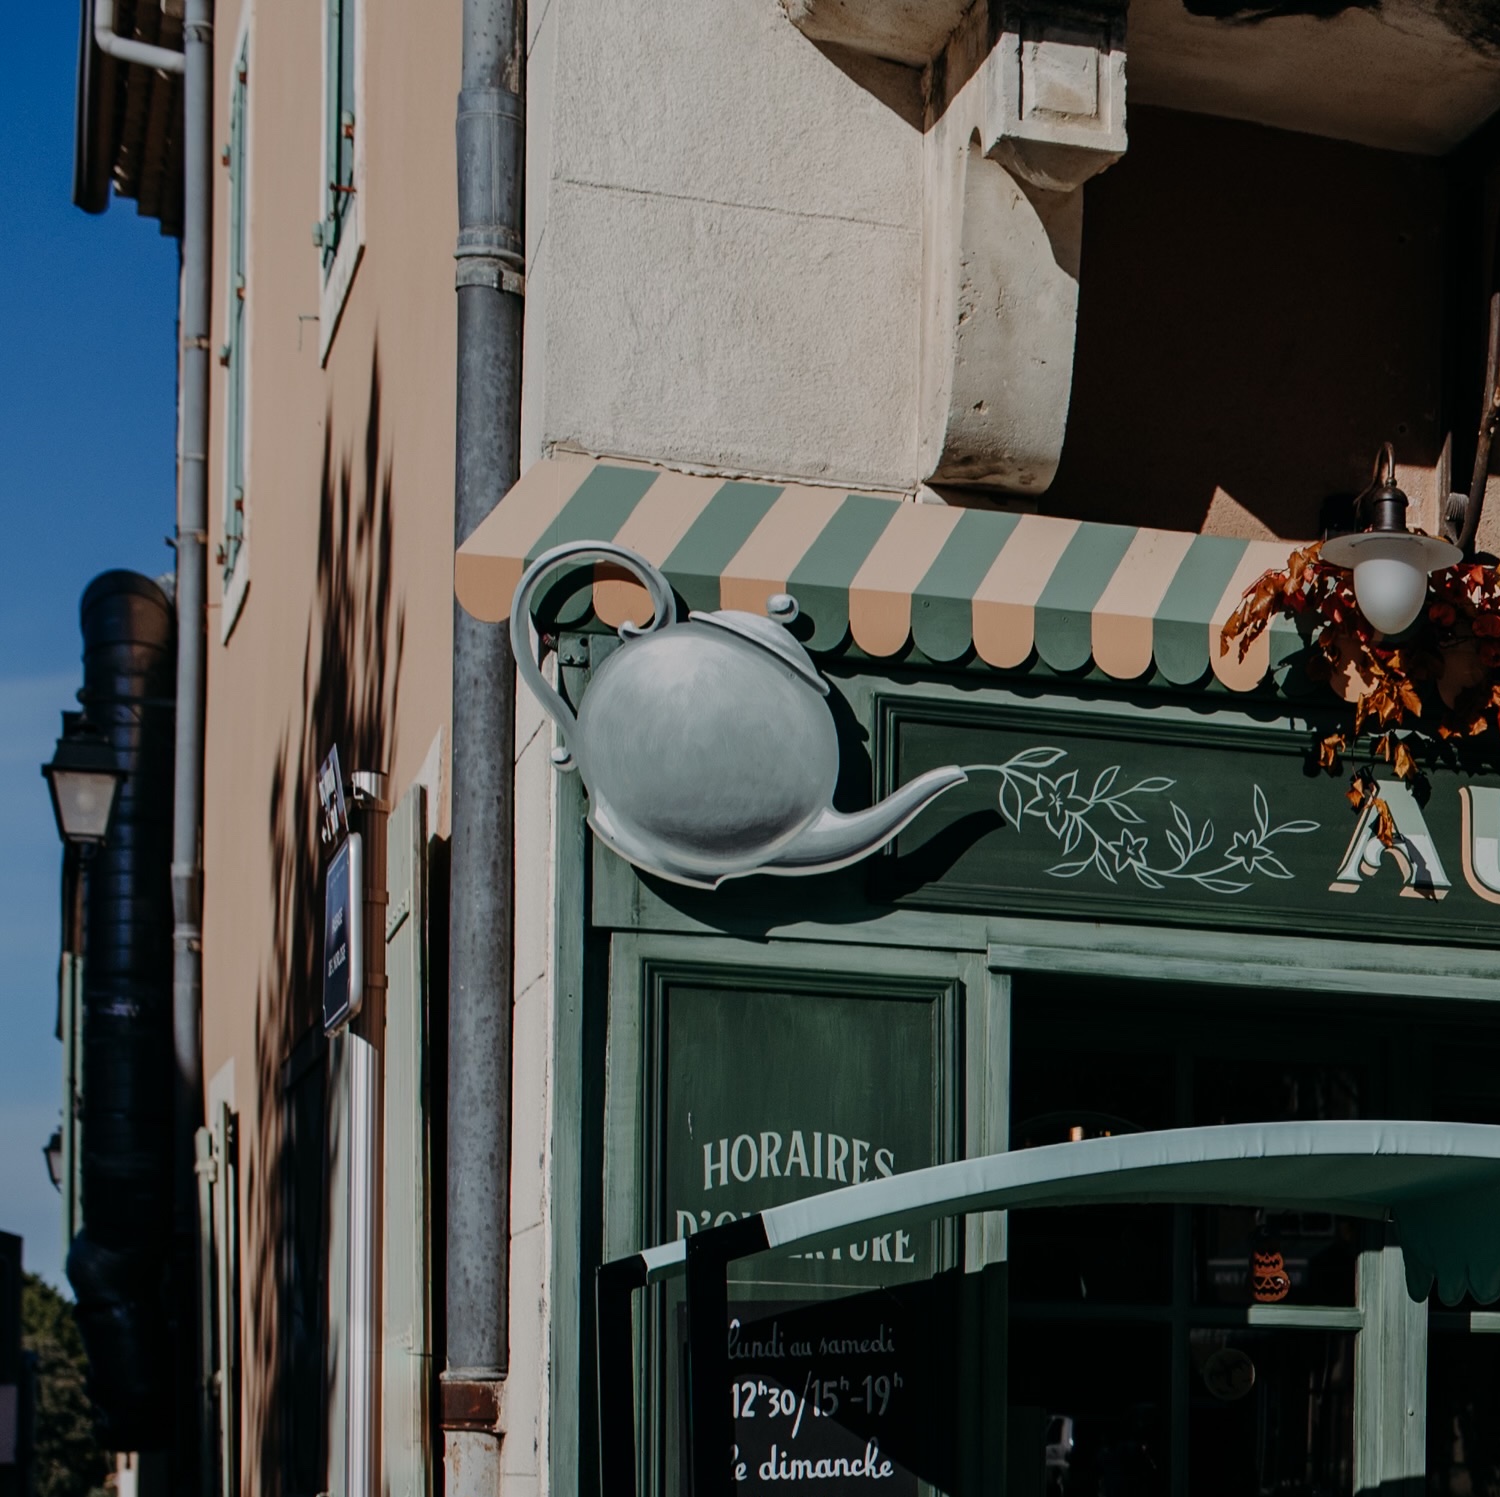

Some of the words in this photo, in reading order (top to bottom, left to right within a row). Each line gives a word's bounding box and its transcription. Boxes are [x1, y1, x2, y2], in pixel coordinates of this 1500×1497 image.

[703, 1130, 895, 1190] HORAIRES
[728, 1318, 786, 1360] lundi
[790, 1341, 813, 1357] au
[819, 1323, 896, 1356] samedi
[760, 1436, 894, 1481] dimanche
